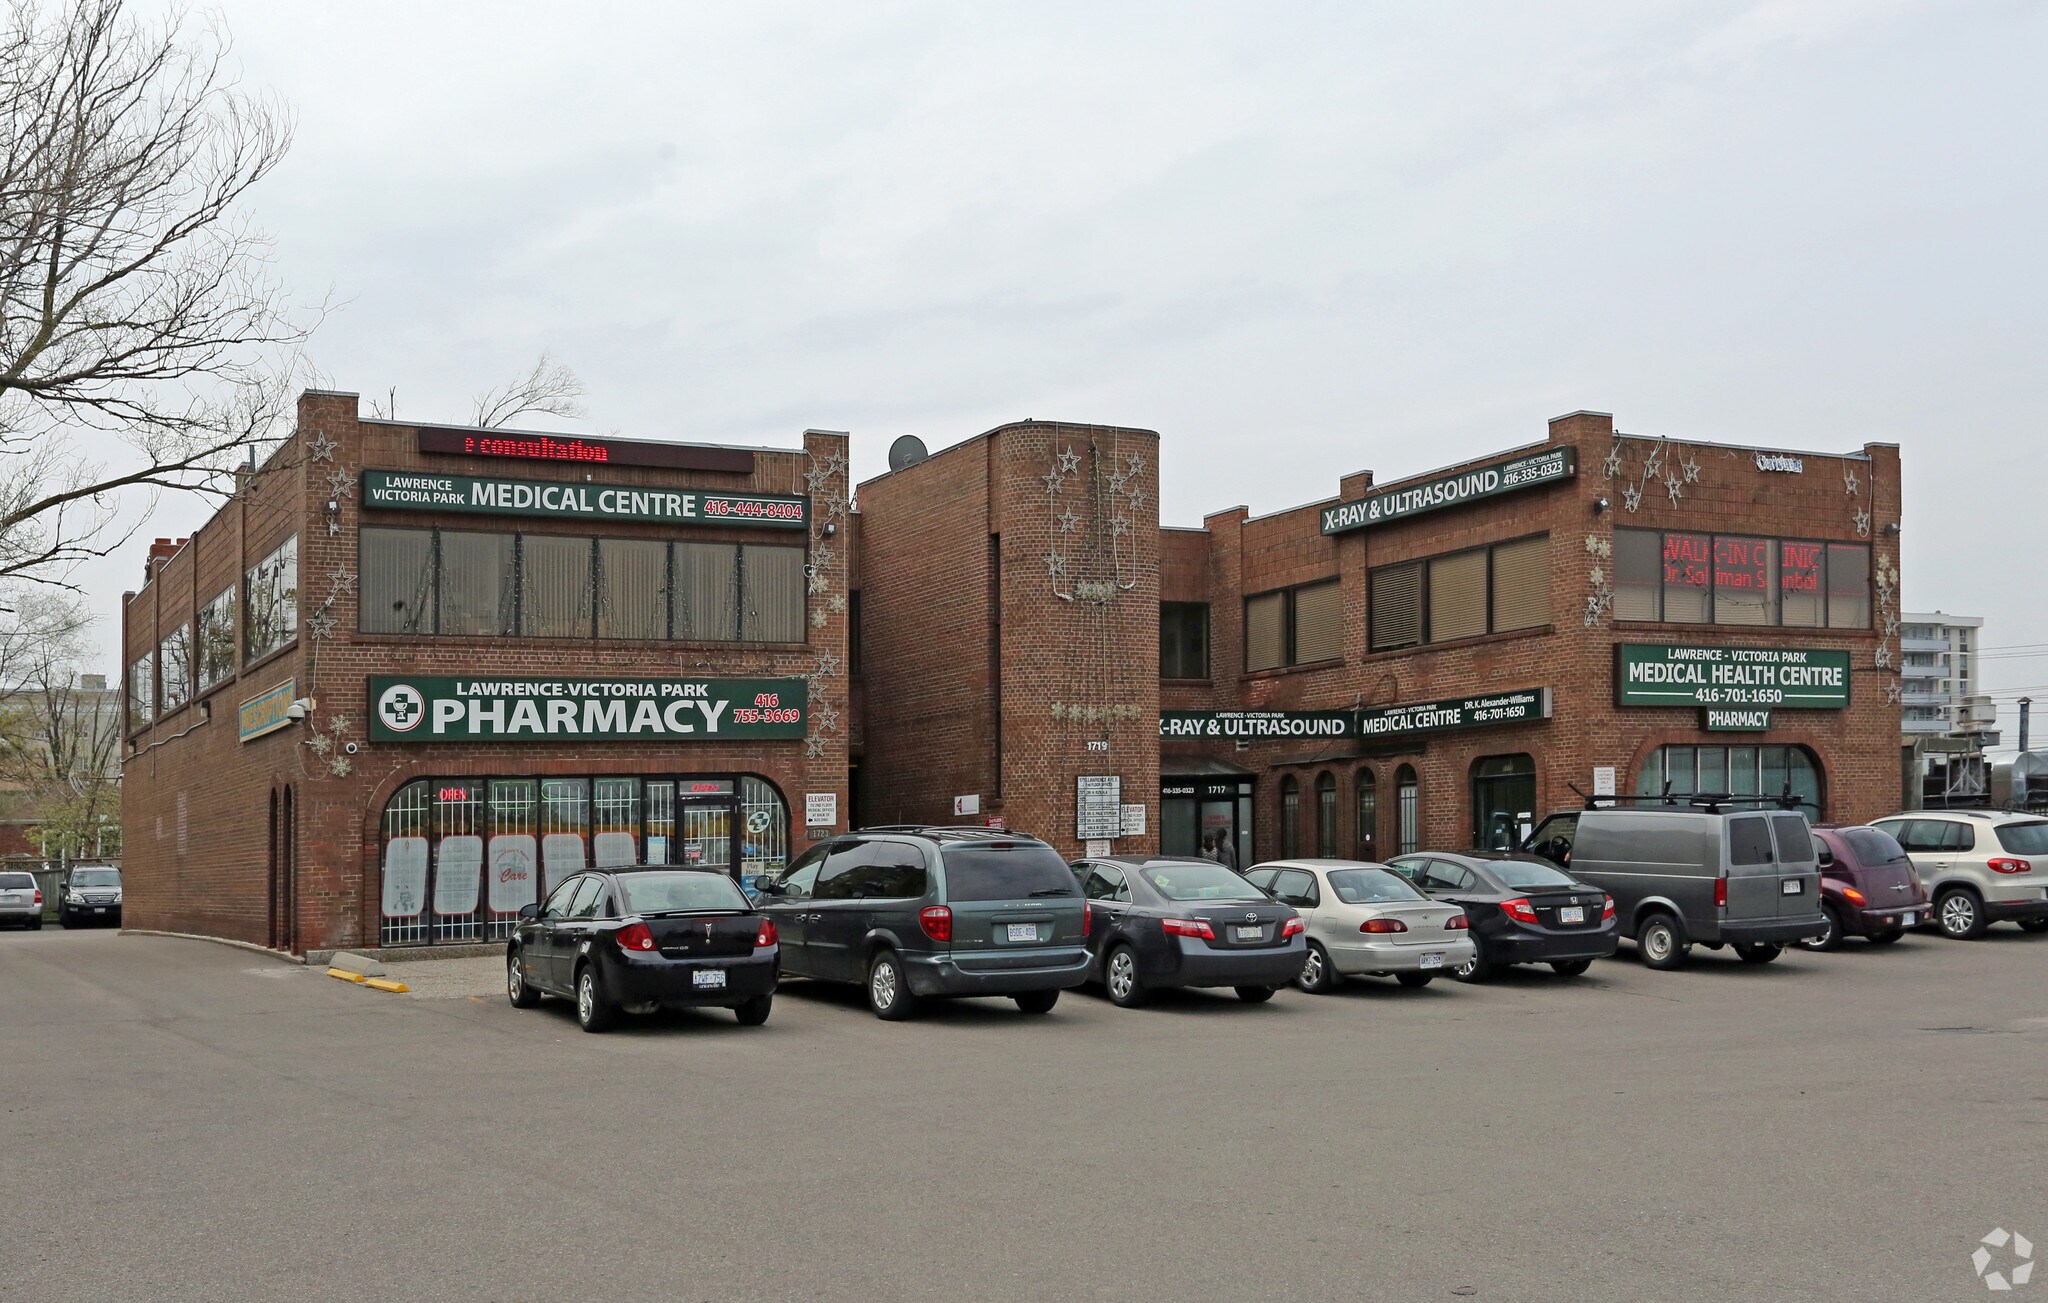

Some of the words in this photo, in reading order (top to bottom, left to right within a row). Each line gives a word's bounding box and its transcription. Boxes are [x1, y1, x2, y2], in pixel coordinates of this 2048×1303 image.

[479, 437, 608, 461] consultation
[1550, 451, 1563, 461] PARK
[1503, 461, 1563, 485] 416-335-0323
[386, 476, 452, 491] LAWRENCE
[372, 488, 430, 502] VICTORIA
[433, 492, 465, 505] PARK
[471, 482, 594, 512] MEDICAL
[598, 490, 696, 517] CENTRE
[1324, 503, 1367, 531] X-RAY
[1369, 501, 1381, 519] &
[1383, 470, 1499, 517] ULTRASOUND
[704, 500, 803, 519] 416-444-8404
[1663, 539, 1747, 565] WALK-IN
[1753, 546, 1820, 569] CINIC
[1667, 648, 1722, 660] LAWRENCE
[1731, 650, 1779, 662] VICTORIA
[1782, 652, 1807, 663] PARK
[1629, 662, 1706, 683] MEDICAL
[1711, 665, 1775, 685] HEALTH
[1779, 666, 1842, 686] CENTRE
[661, 684, 709, 697] PARK
[1695, 688, 1782, 703] 416-701-1650
[755, 694, 779, 708] 416
[1464, 701, 1474, 710] DR.
[1475, 700, 1481, 708] K.
[1481, 694, 1535, 708] Alexander-Williams
[432, 699, 730, 734] PHARMACY
[733, 709, 800, 723] 755-3669
[1363, 715, 1414, 734] MEDICAL
[1415, 709, 1461, 727] CENTRE
[1473, 706, 1525, 722] 416-701-1650
[1708, 711, 1769, 727] PHARMACY
[1206, 719, 1221, 735] &
[1224, 719, 1345, 735] ULTRASOUND
[1087, 741, 1109, 751] 1719
[438, 788, 468, 800] OPEN
[691, 783, 719, 792] OPEN
[1208, 786, 1226, 794] 1717
[813, 829, 828, 838] 1723
[500, 868, 528, 883] Care
